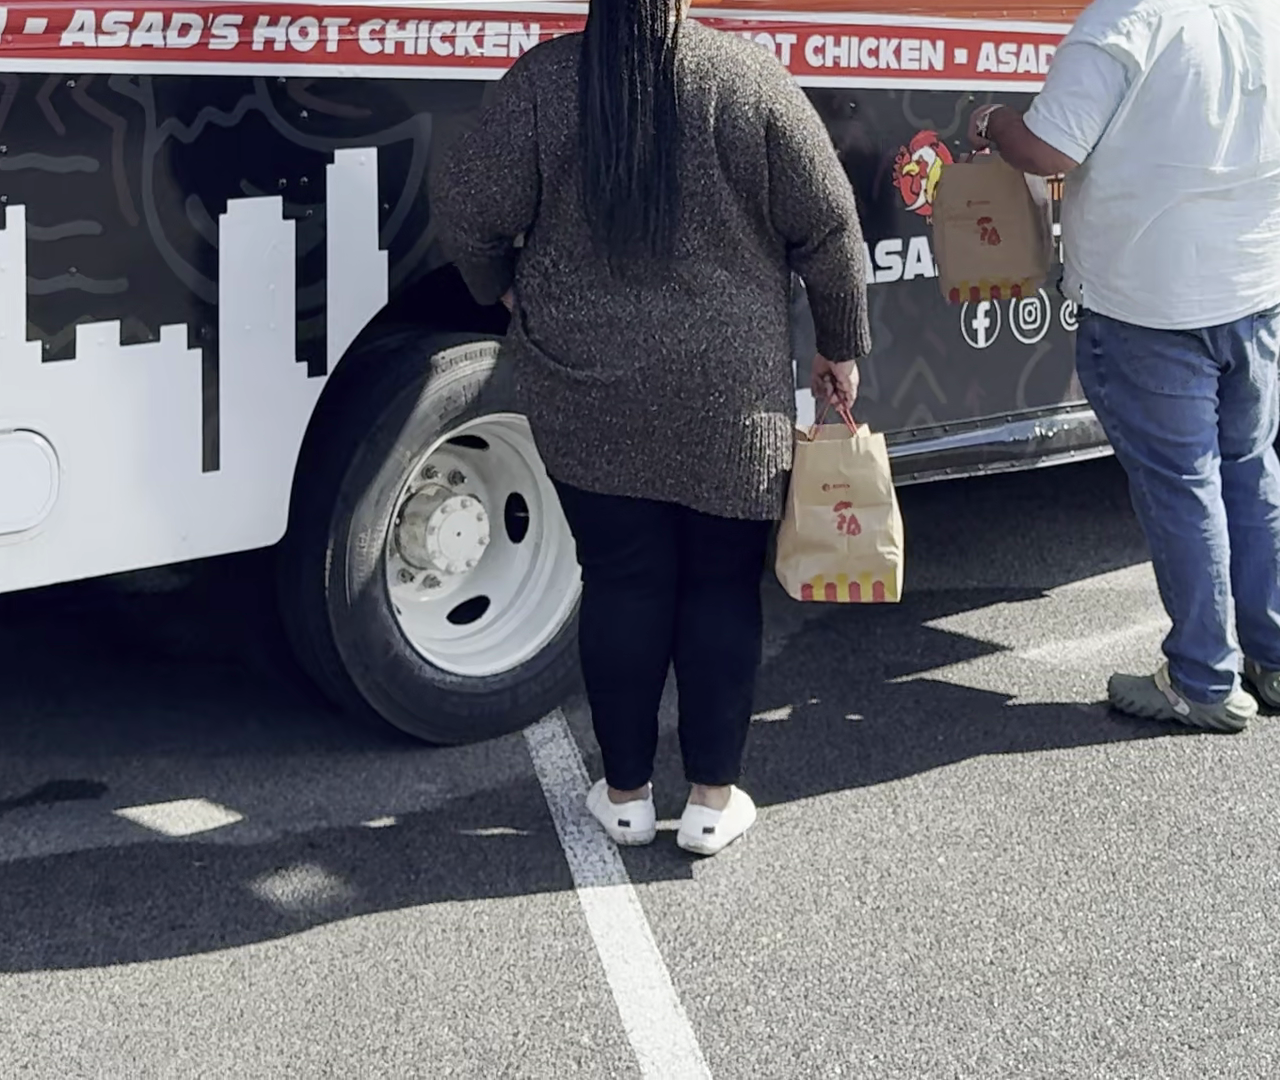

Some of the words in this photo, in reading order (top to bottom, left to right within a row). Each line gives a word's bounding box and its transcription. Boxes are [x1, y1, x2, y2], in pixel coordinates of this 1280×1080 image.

[60, 9, 242, 51] ASAD'S
[253, 15, 351, 54] HOT
[357, 18, 540, 60] CHICKEN
[805, 34, 945, 71] CHICKEN
